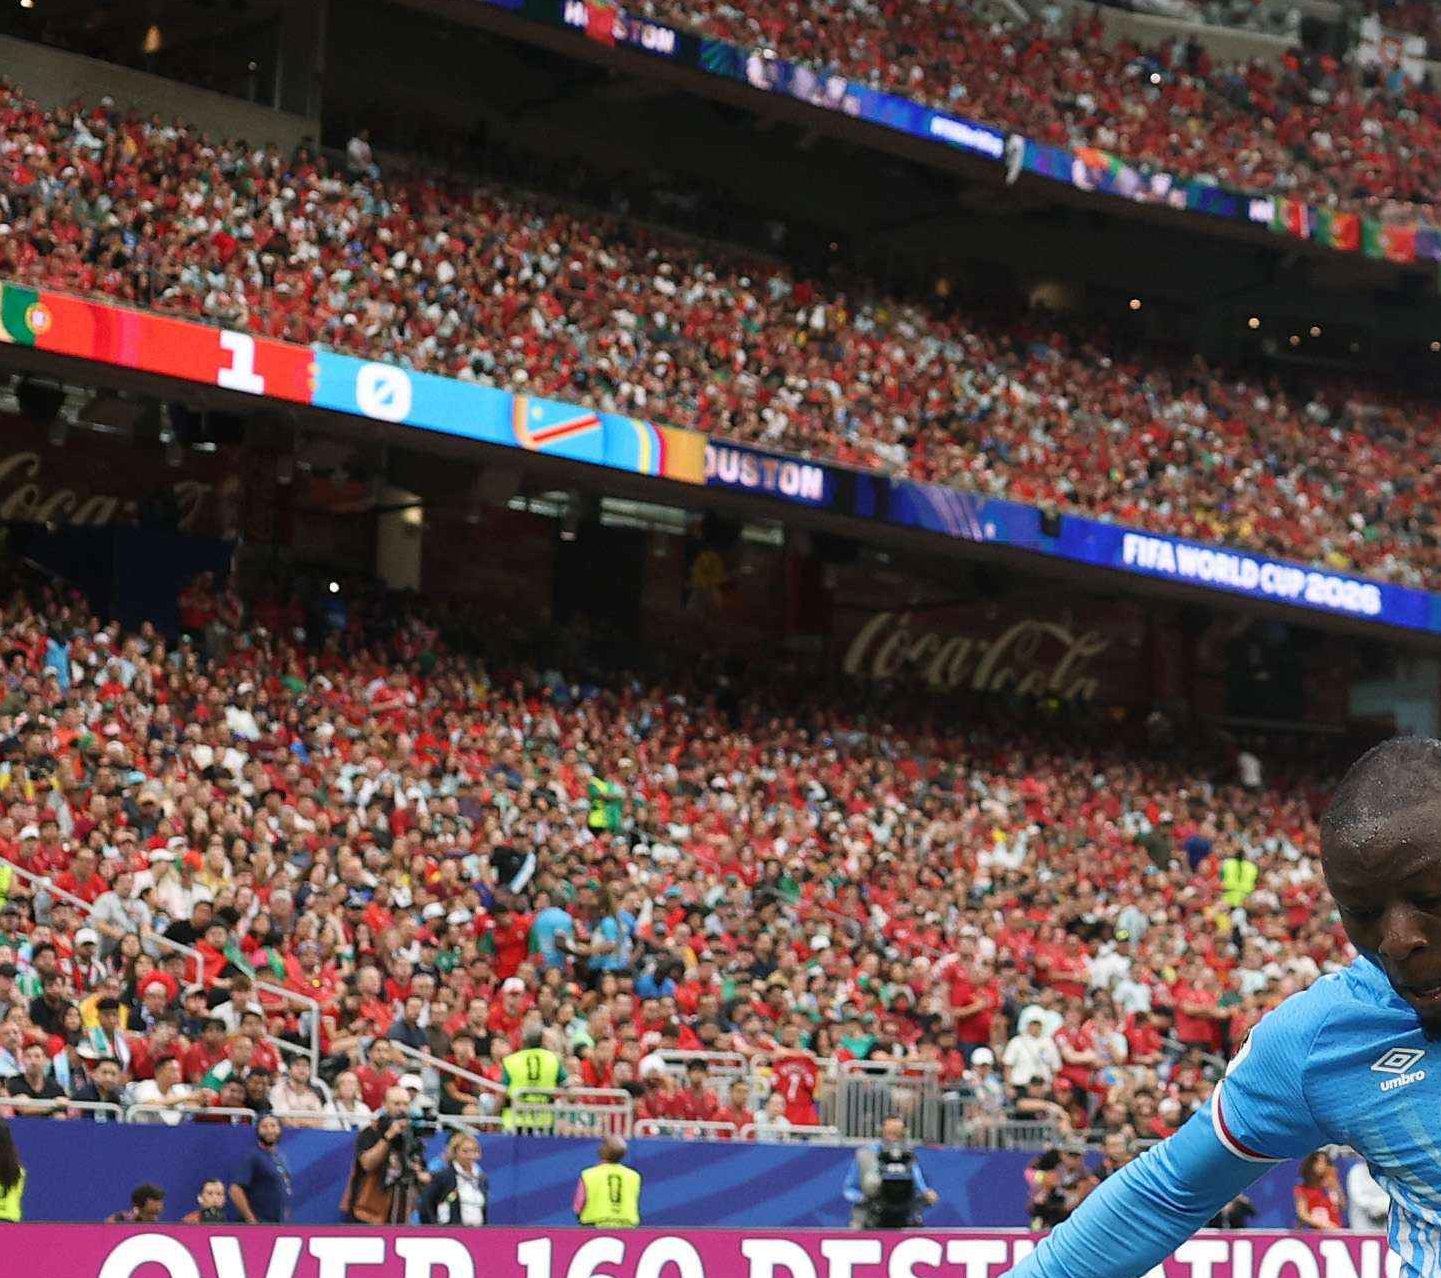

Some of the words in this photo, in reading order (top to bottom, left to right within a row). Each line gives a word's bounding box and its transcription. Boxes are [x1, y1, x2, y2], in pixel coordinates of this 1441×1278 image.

[218, 328, 265, 395] 1
[356, 361, 412, 422] 0
[703, 444, 825, 502] OUSTON
[1123, 532, 1176, 574] FIFA
[1176, 543, 1259, 590] WORLD
[1259, 562, 1306, 599] CUP
[1304, 571, 1382, 616] 2026
[1380, 1069, 1426, 1092] umbro
